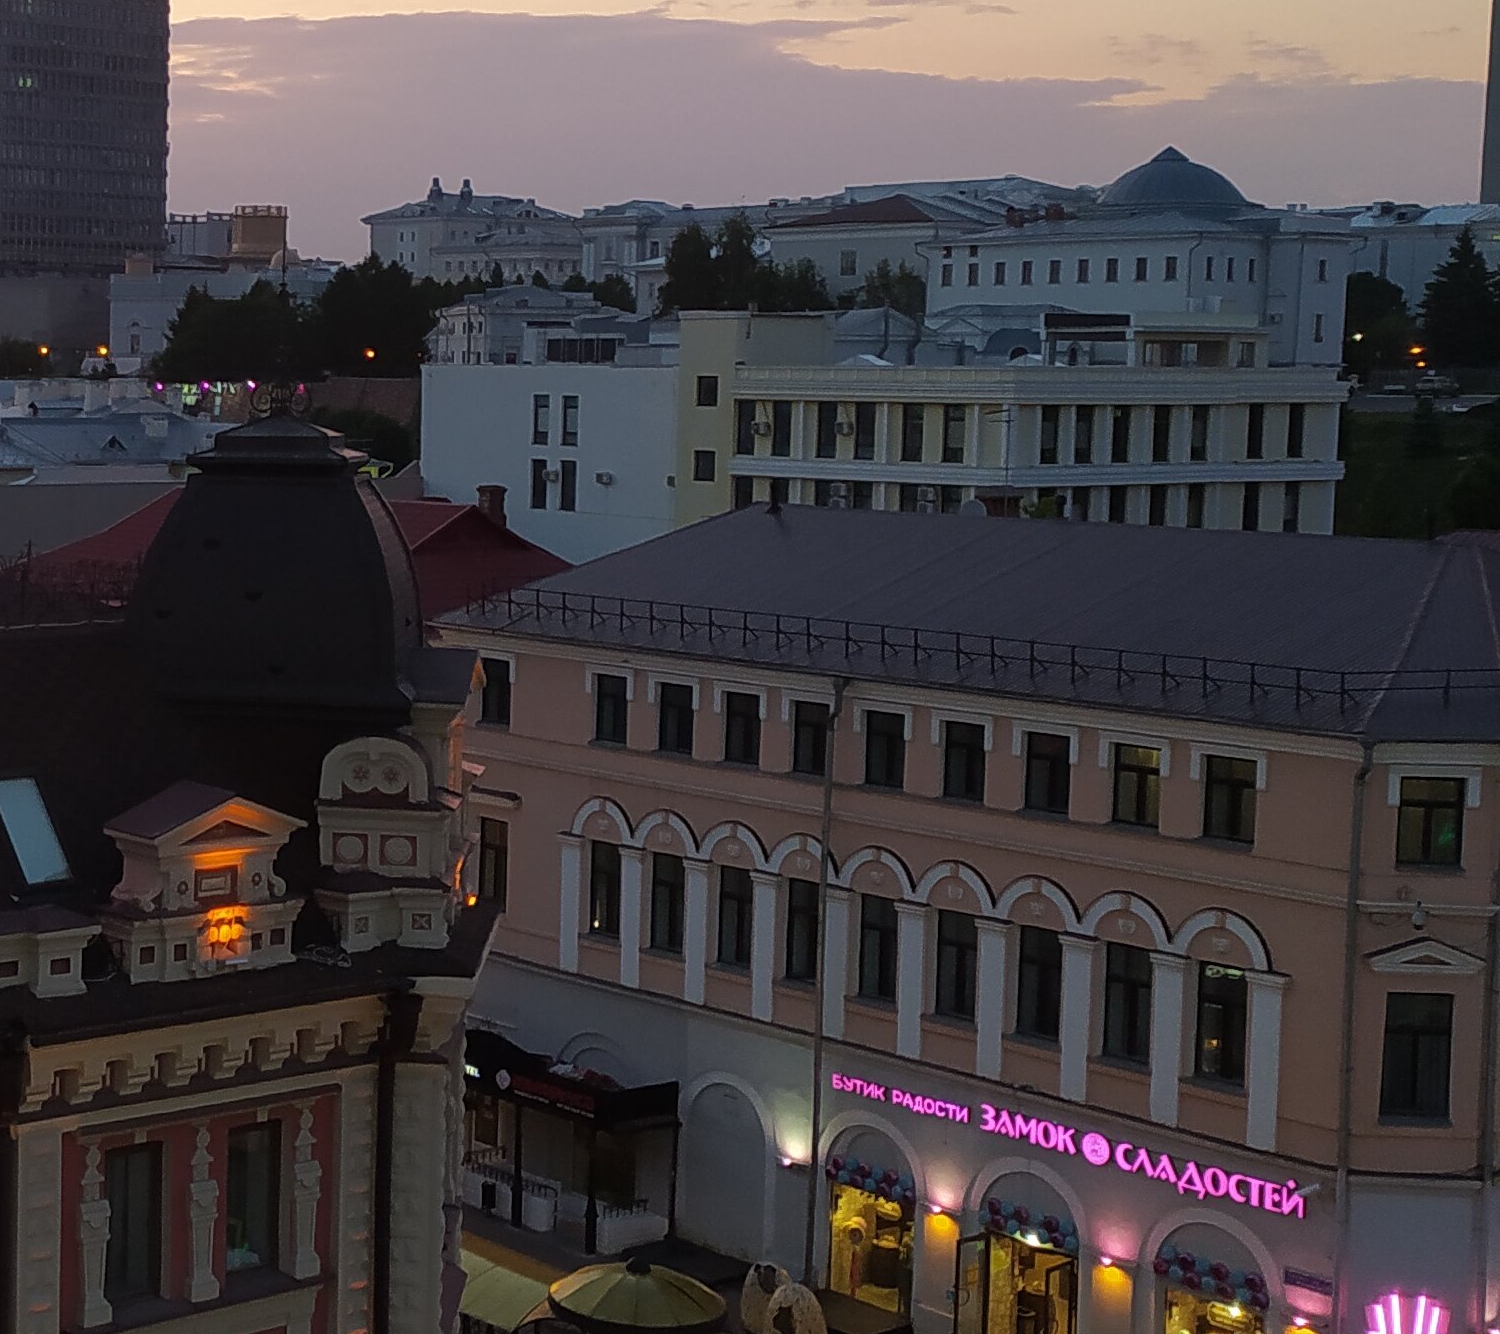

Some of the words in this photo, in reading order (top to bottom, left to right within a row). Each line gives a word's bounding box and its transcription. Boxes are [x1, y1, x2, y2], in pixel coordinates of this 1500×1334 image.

[832, 1073, 886, 1101] БУТИК
[893, 1089, 970, 1123] РАДОСТИ
[980, 1103, 1077, 1155] ЗАМОК
[1116, 1142, 1304, 1218] СЛАДОСТЕЙ
